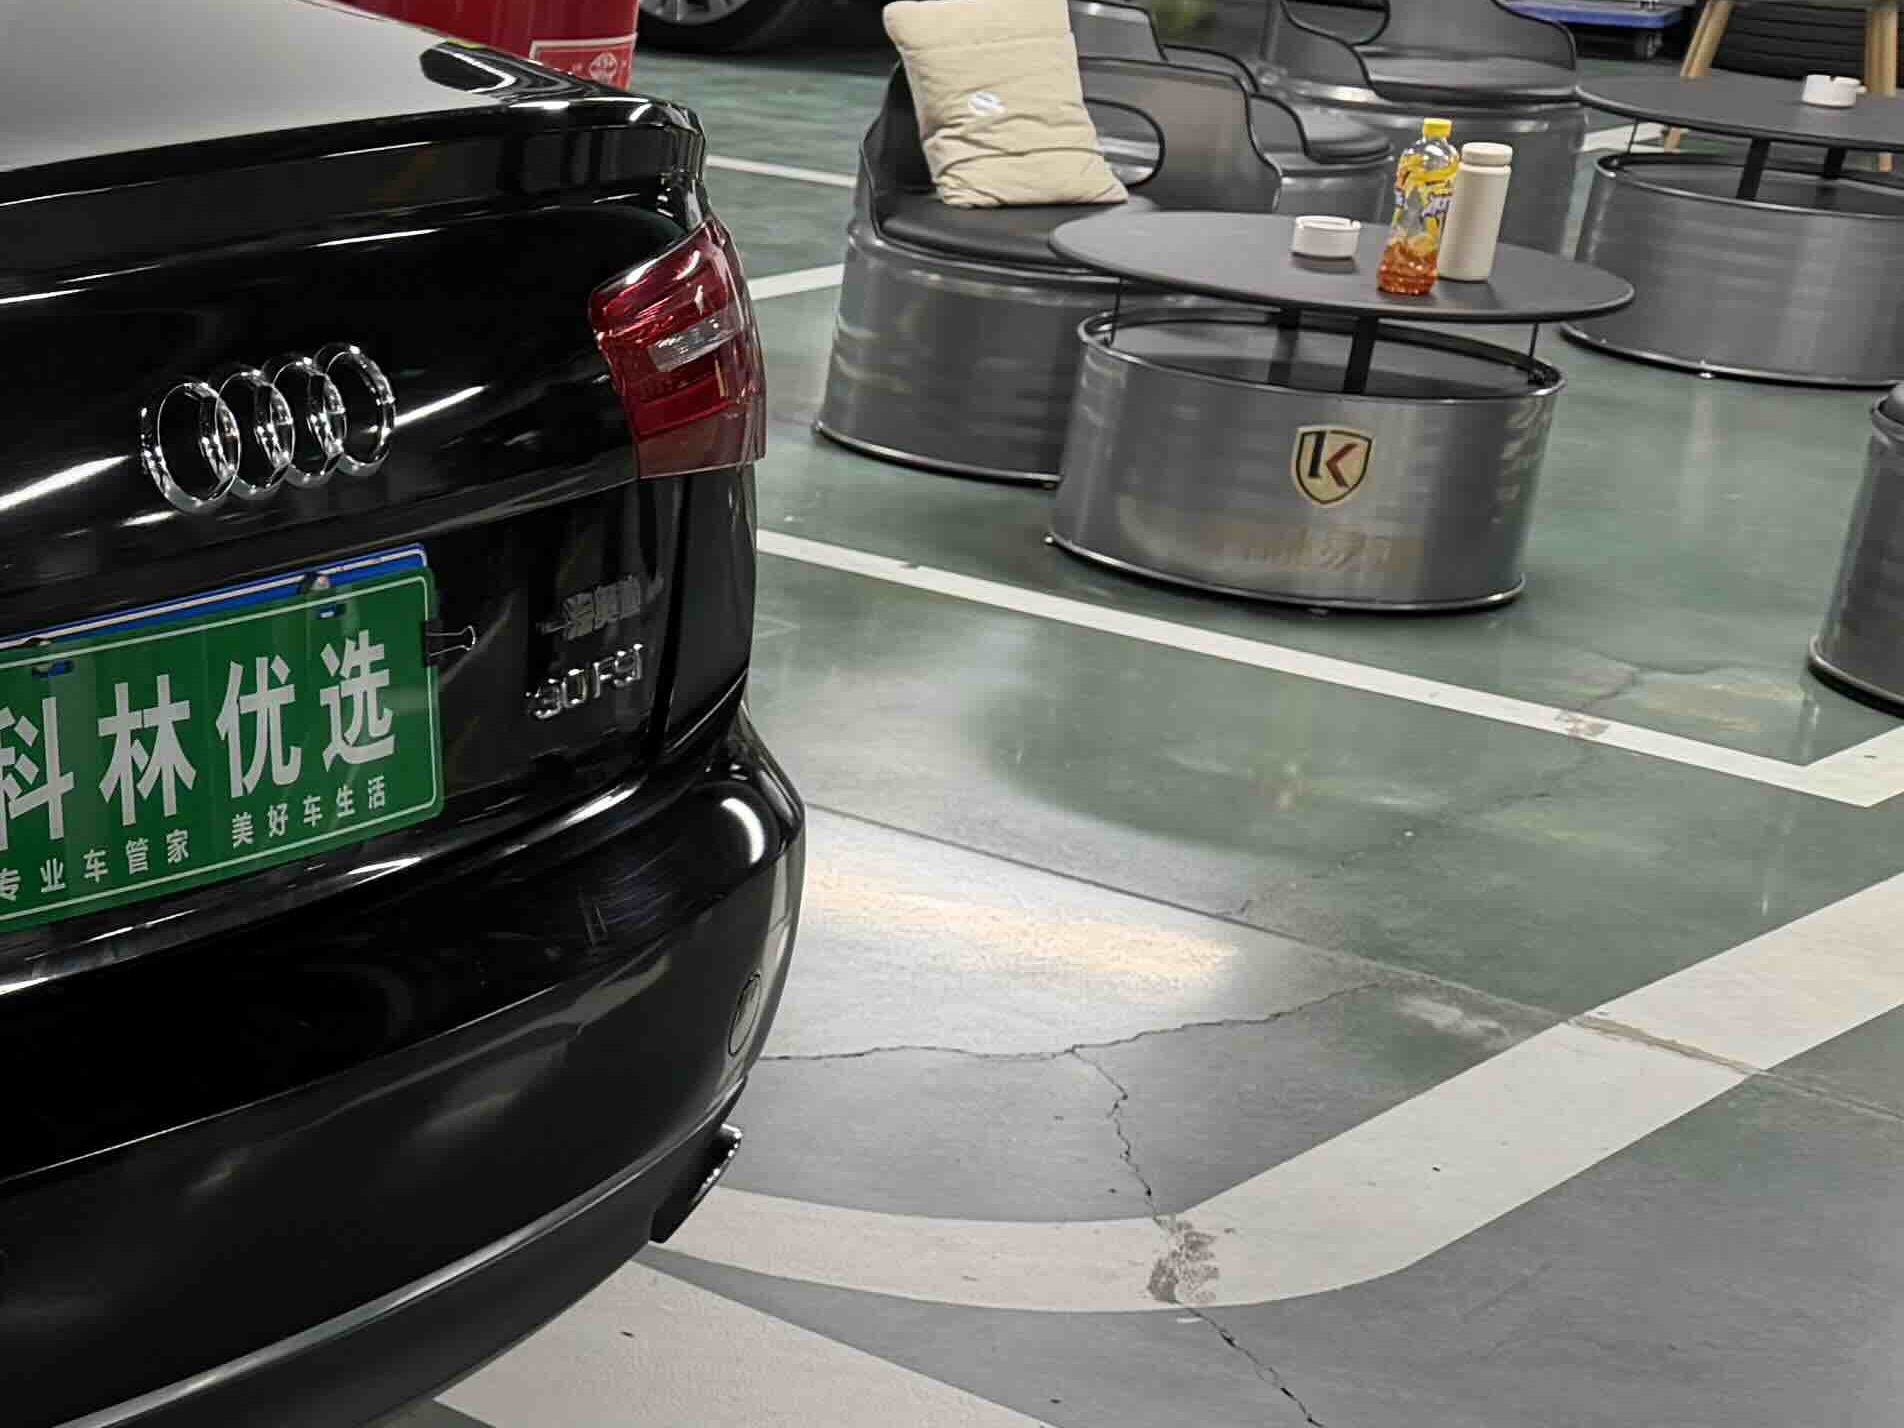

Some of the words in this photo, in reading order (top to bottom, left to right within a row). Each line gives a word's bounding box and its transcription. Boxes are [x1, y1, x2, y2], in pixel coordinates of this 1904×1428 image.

[230, 774, 387, 849] 美好车生活
